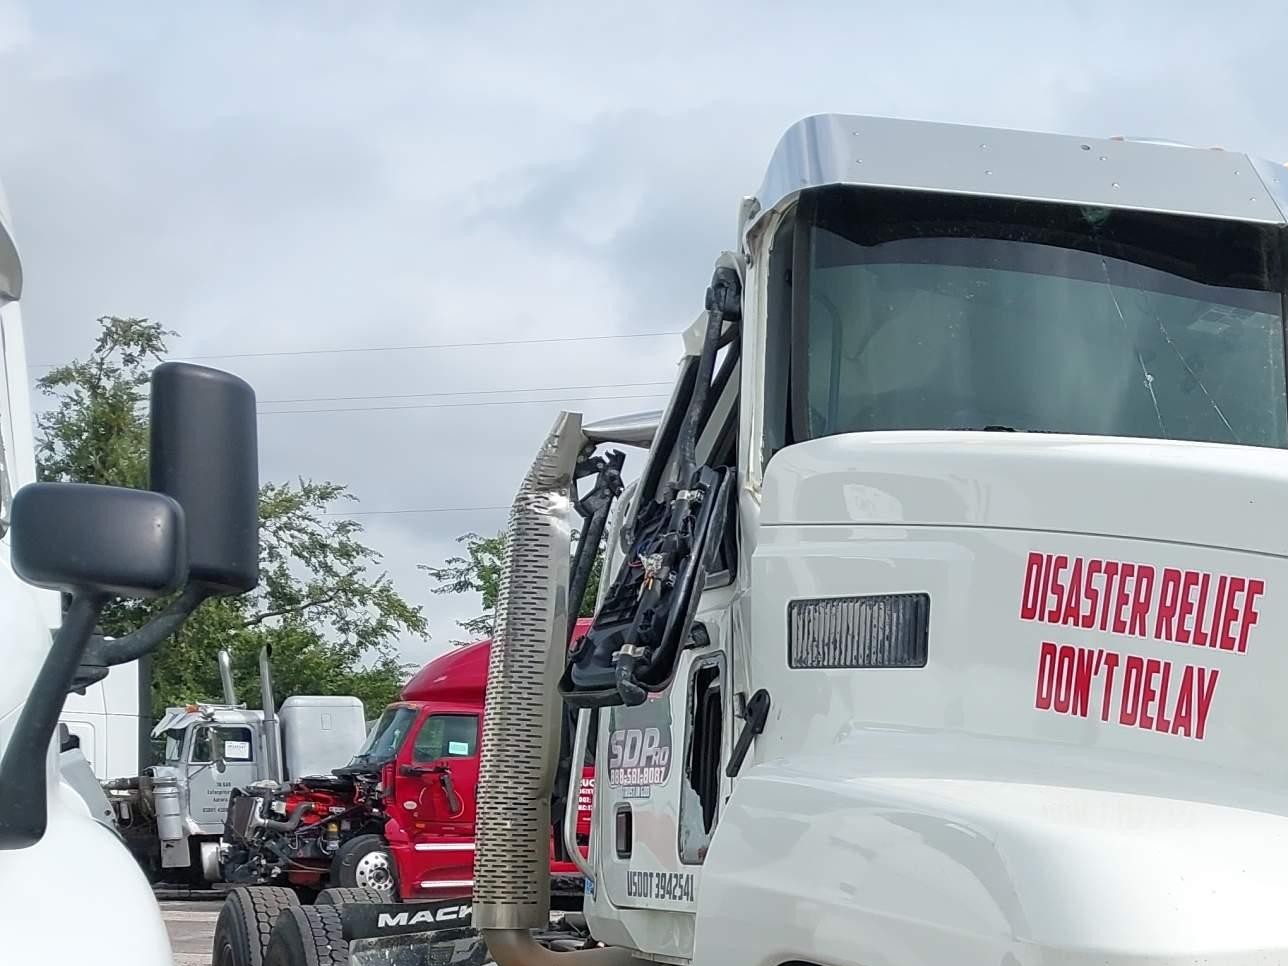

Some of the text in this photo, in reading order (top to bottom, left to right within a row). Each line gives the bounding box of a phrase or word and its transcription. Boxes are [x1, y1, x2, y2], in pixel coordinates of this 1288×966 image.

[1020, 551, 1265, 655] DISASTER RELIEF
[1034, 641, 1220, 741] DON'T DELAY
[627, 870, 653, 898] USDOT
[655, 871, 694, 902] 3942541
